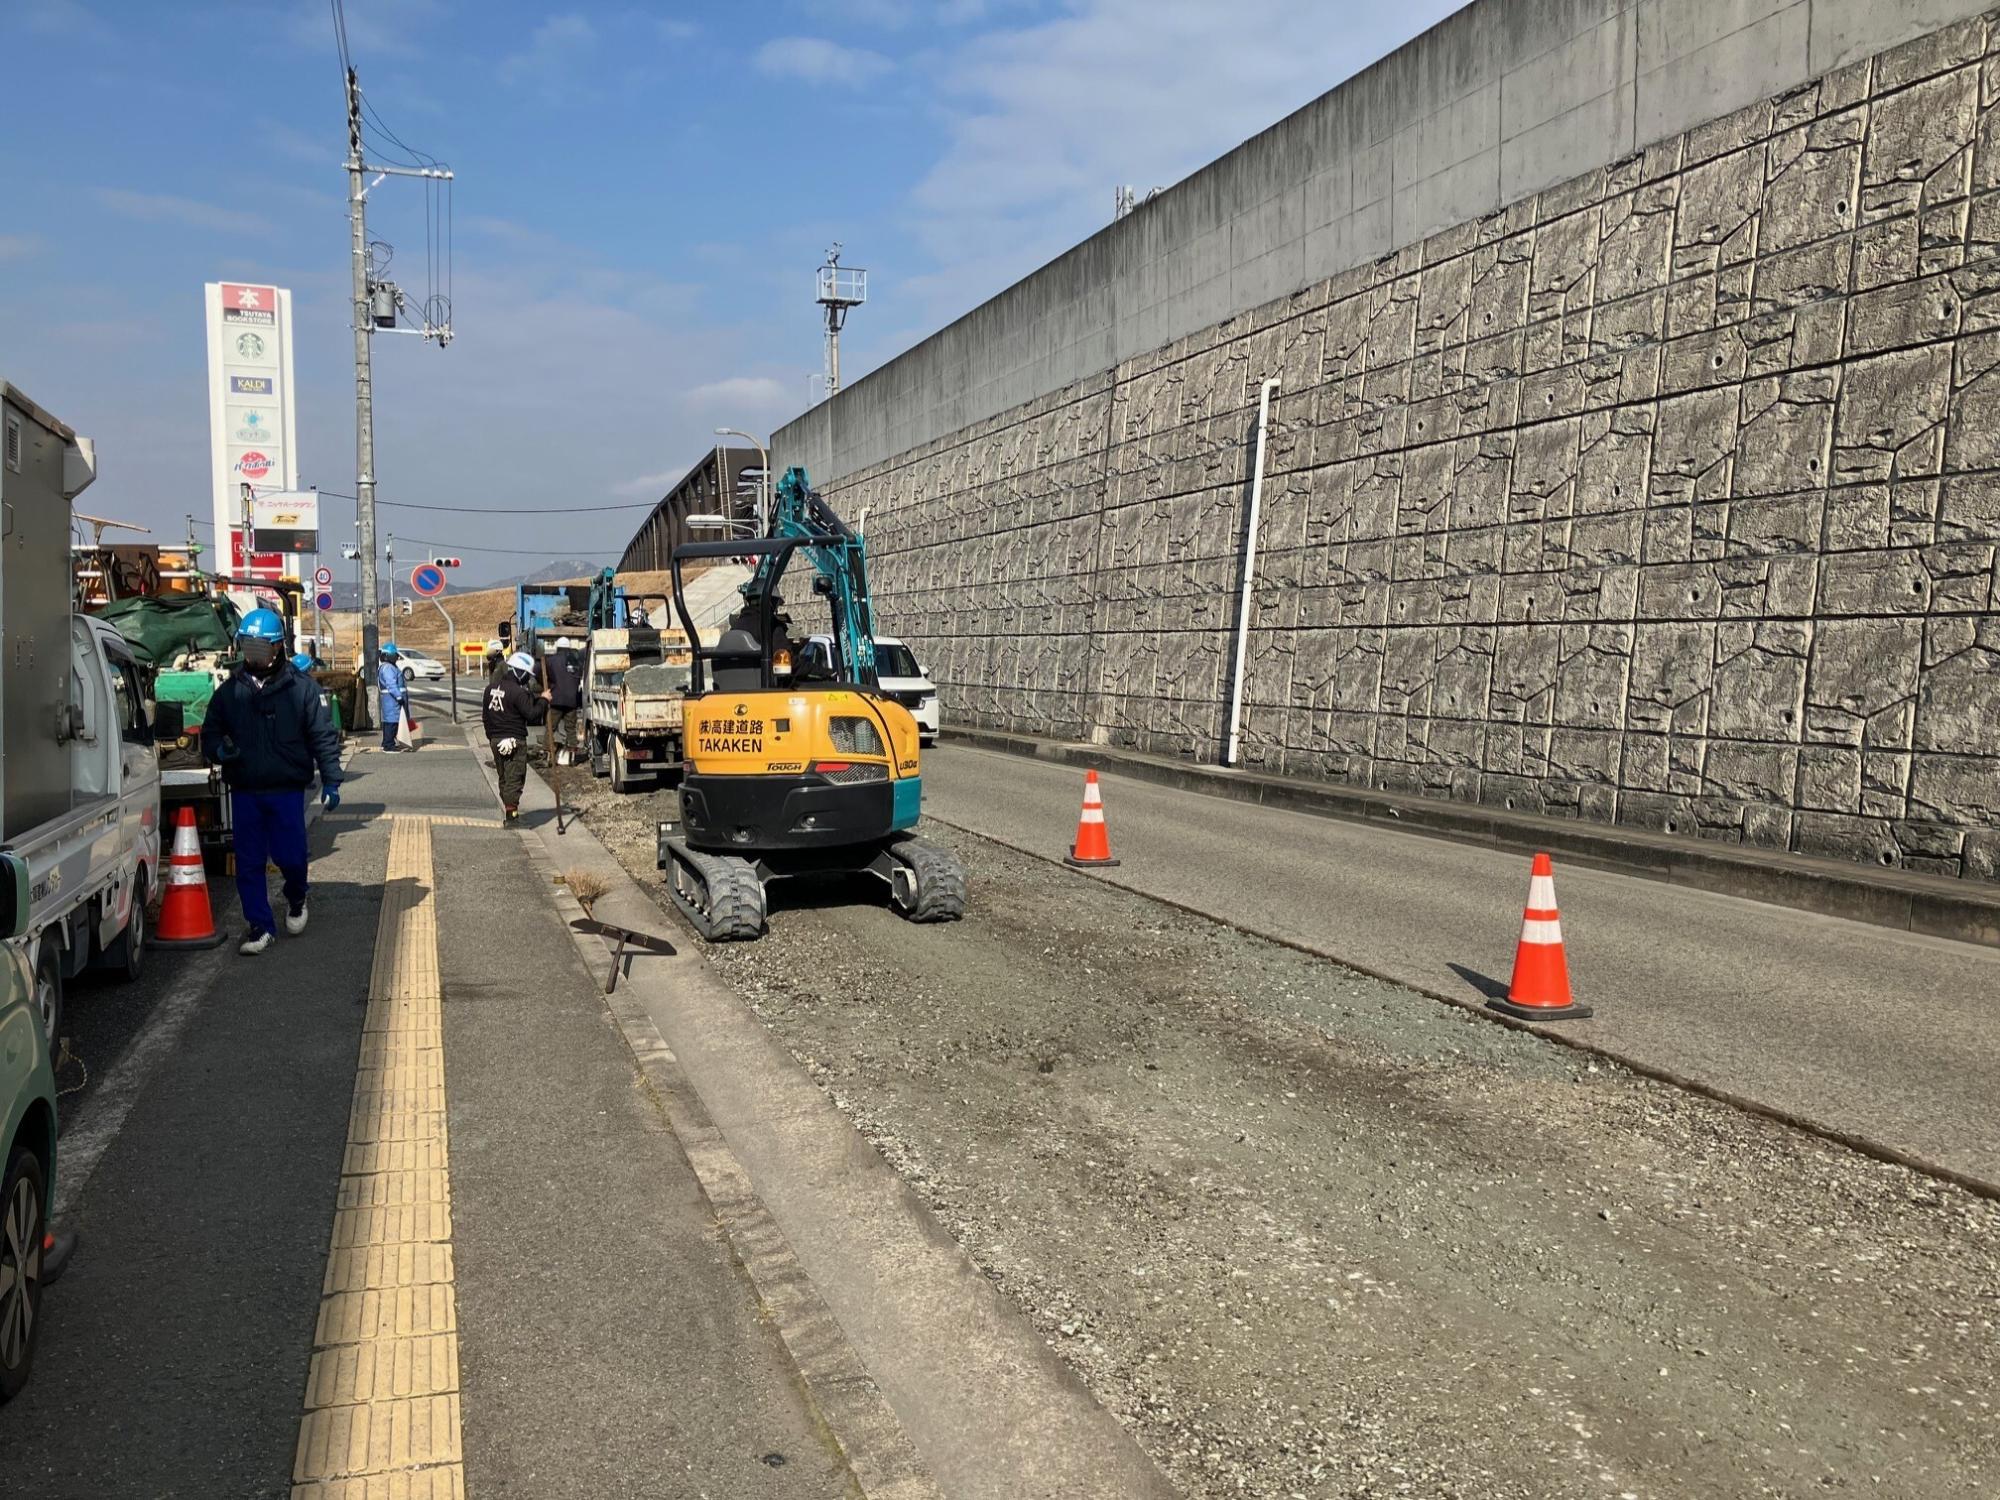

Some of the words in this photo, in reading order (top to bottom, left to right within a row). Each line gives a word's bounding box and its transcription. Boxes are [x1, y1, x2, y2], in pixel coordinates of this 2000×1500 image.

[240, 310, 272, 318] TSUTAYA
[237, 379, 265, 389] KALDI
[319, 572, 328, 580] 40
[699, 738, 762, 752] TAKAKEN
